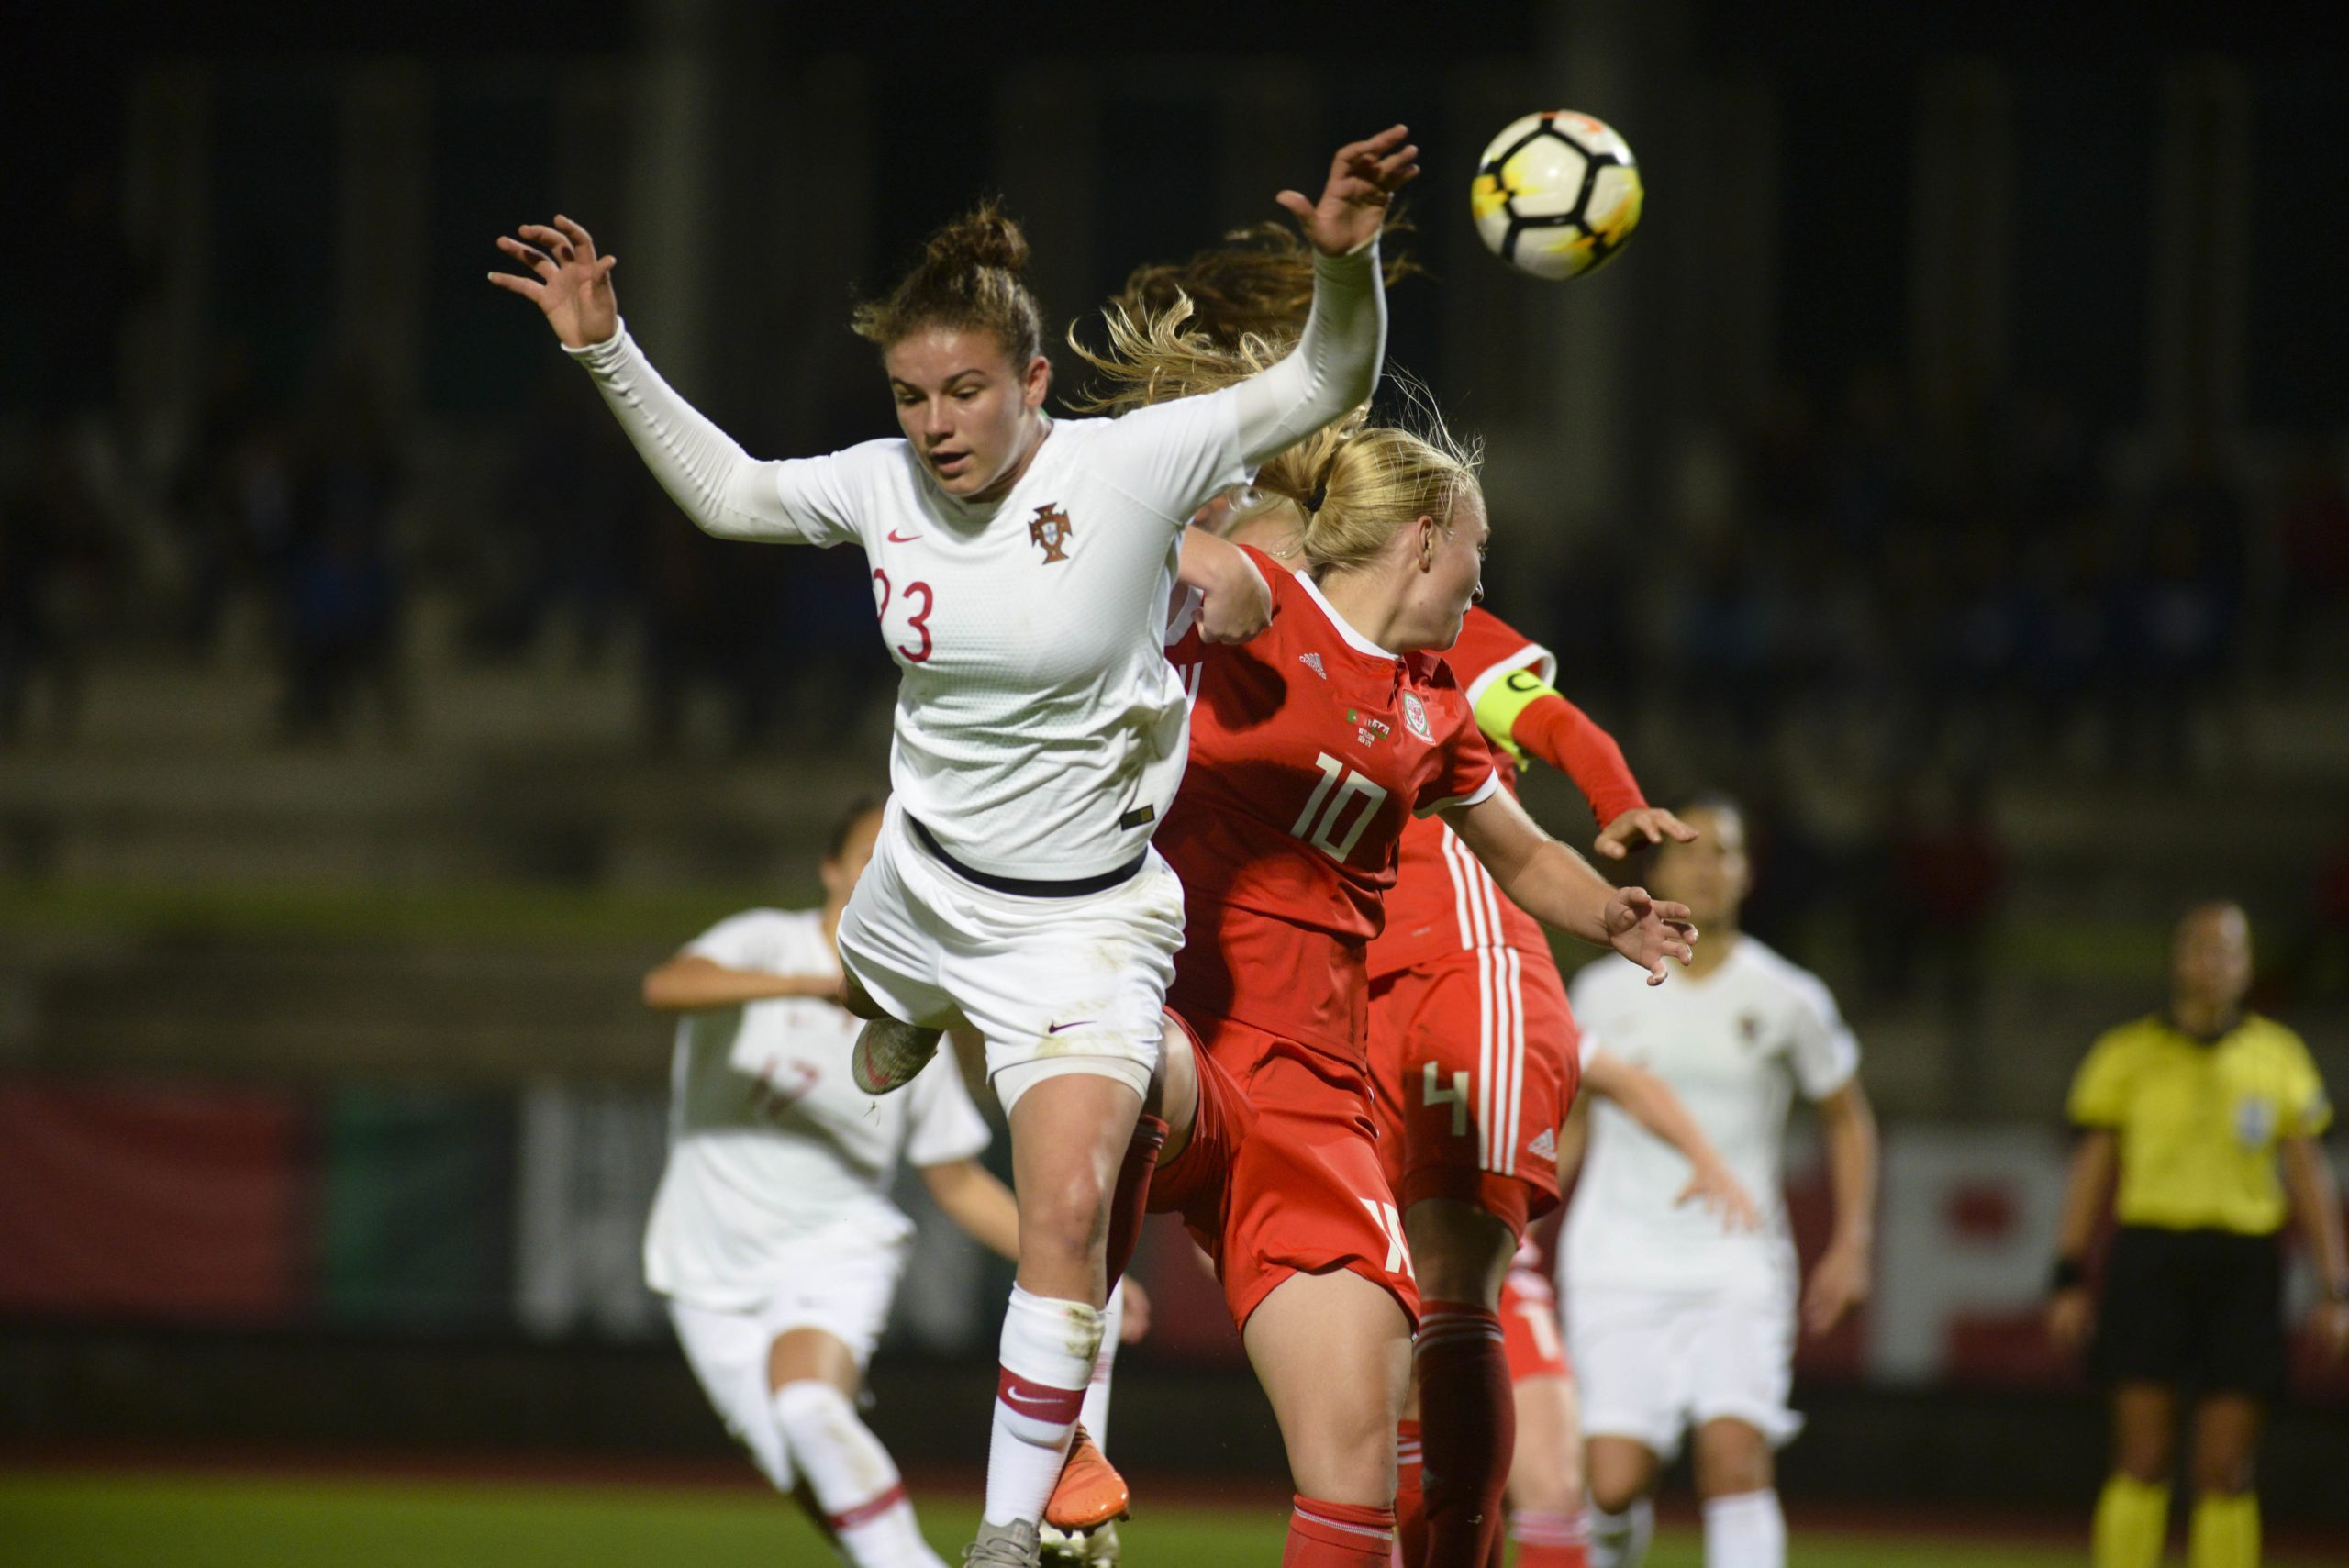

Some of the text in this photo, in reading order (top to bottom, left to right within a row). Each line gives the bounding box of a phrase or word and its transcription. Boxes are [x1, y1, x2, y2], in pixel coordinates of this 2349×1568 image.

[1506, 673, 1541, 693] C
[1290, 751, 1388, 864] 10
[1423, 1061, 1470, 1137] 4
